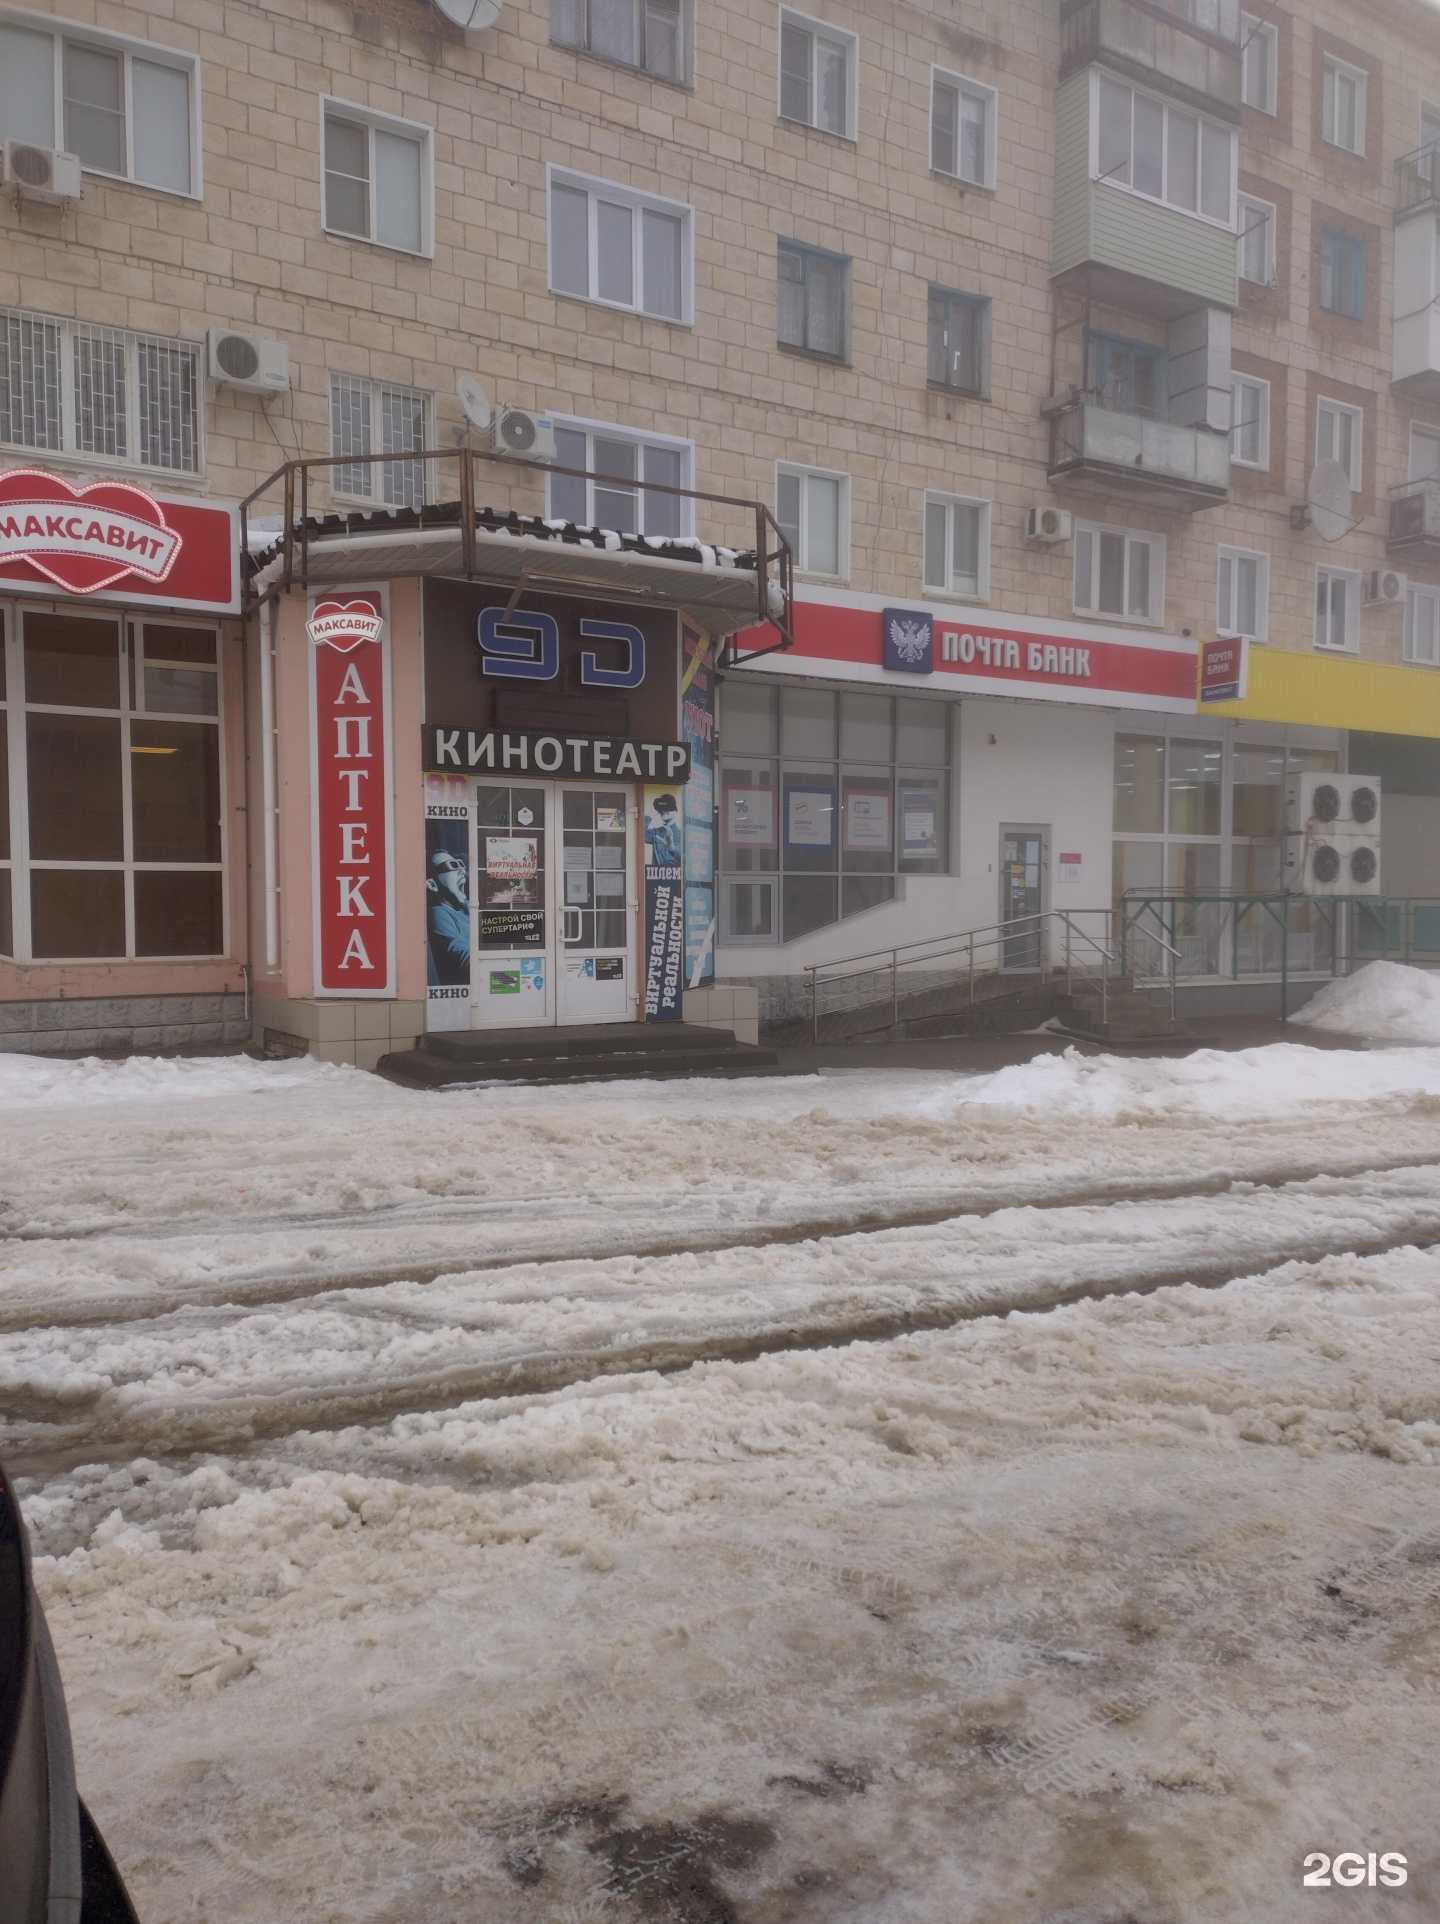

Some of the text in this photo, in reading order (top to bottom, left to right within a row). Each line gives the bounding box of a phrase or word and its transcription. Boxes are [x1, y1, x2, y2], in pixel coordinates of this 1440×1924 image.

[0, 515, 164, 560] МАКСАВИТ
[313, 619, 377, 635] МАКСАВИТ
[942, 631, 1091, 677] ПОЧТА БАНК
[436, 728, 687, 777] КИНОТЕАТР
[333, 662, 375, 970] АПТЕКА
[520, 911, 544, 922] СВОЙ
